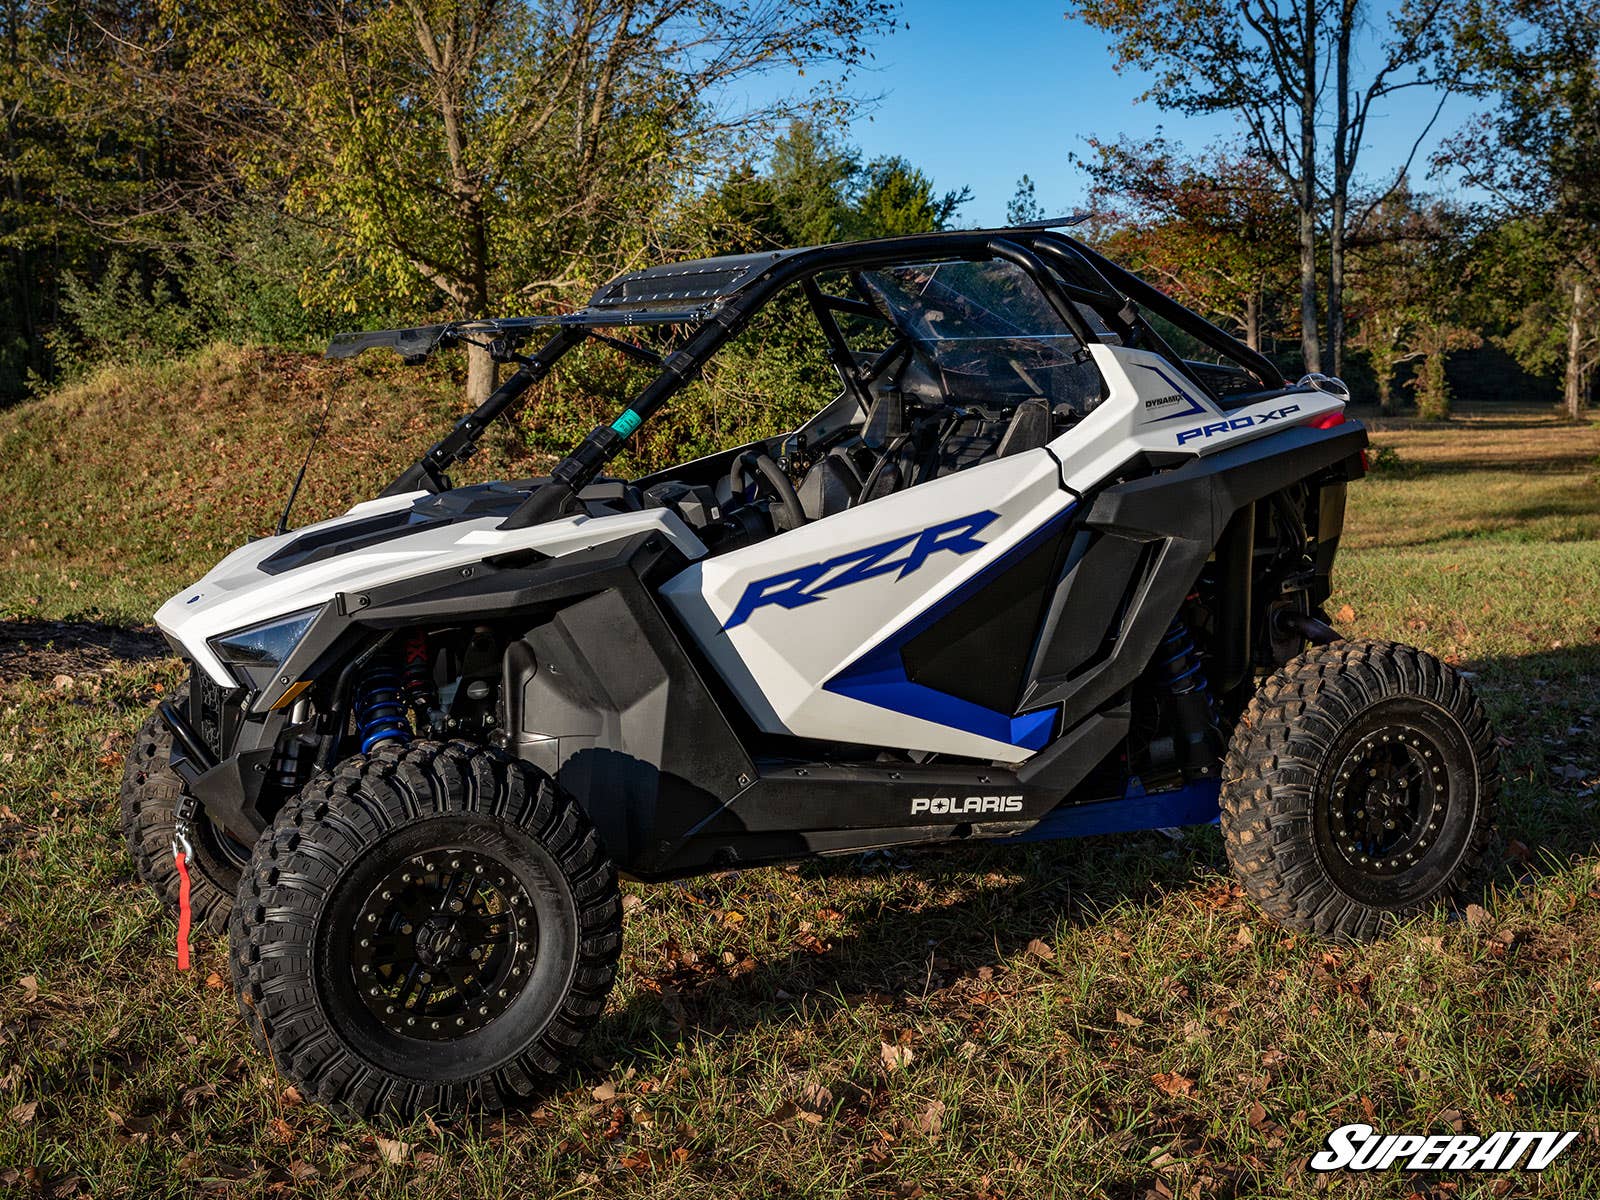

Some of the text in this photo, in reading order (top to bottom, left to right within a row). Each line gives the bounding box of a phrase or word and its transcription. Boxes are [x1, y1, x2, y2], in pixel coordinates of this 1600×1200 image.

[1145, 394, 1184, 408] DYNAMIX
[716, 509, 1002, 635] RZR
[911, 795, 1024, 815] POLARIS
